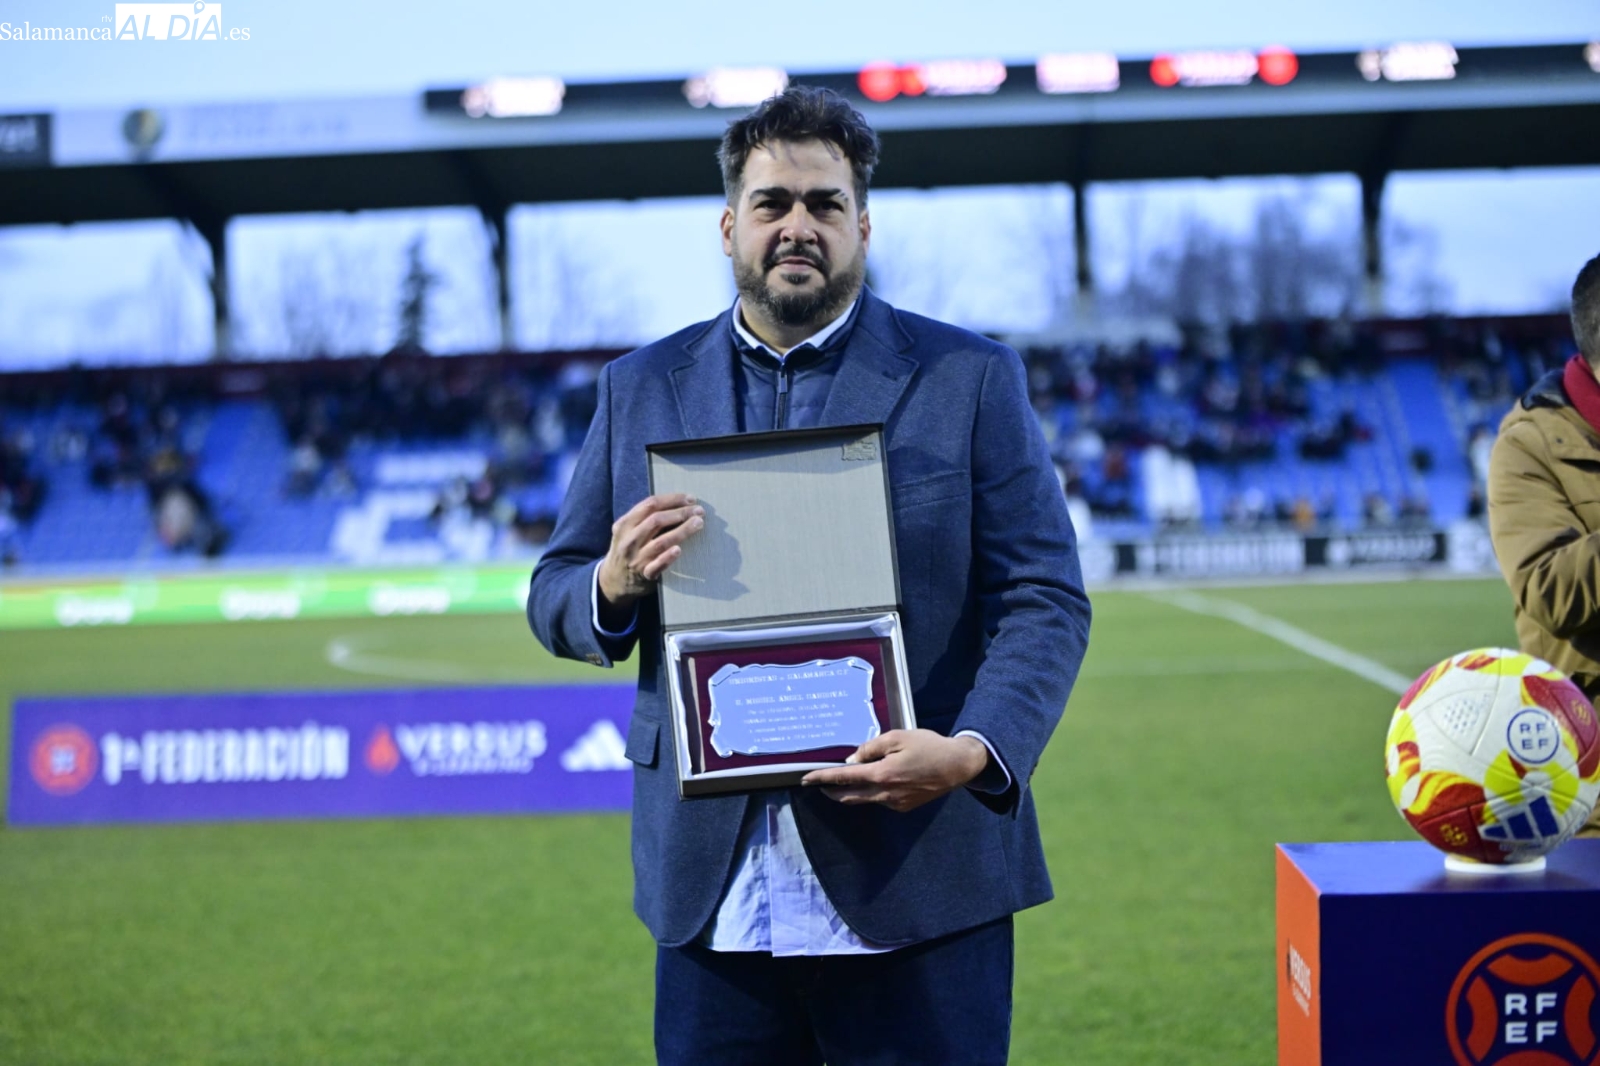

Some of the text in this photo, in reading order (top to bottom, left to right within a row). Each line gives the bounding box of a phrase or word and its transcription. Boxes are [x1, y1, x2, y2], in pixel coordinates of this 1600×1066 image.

[396, 719, 547, 760] VERSUS
[1519, 722, 1547, 735] RF
[1521, 738, 1550, 751] EF
[1505, 993, 1558, 1015] RF
[1505, 1021, 1558, 1044] EF
